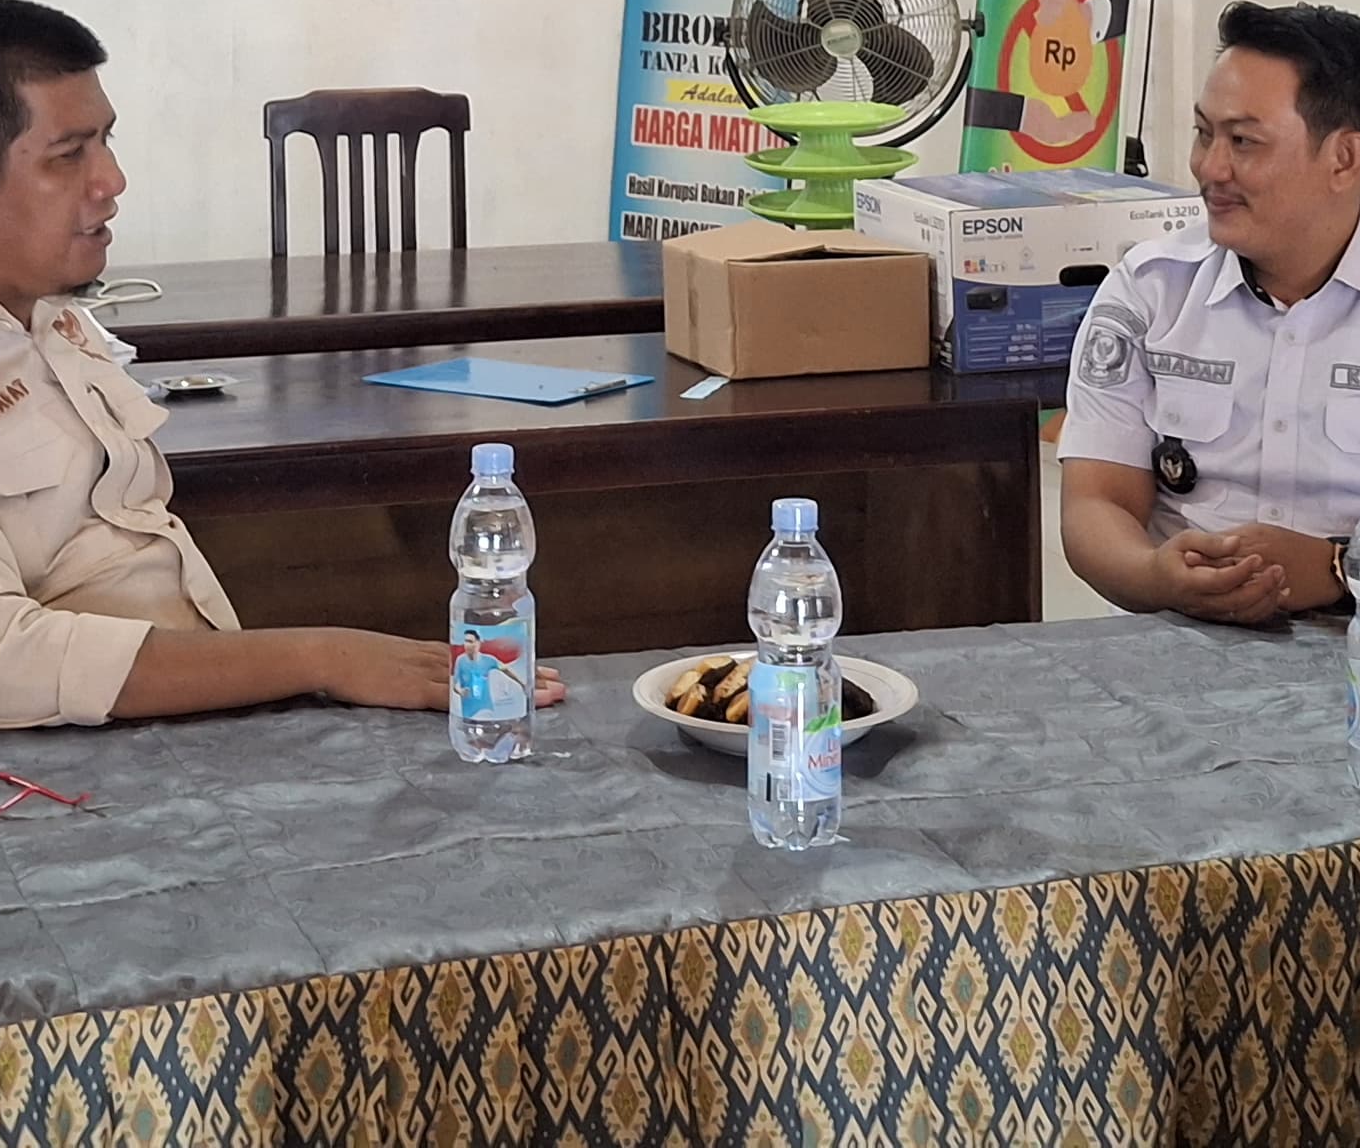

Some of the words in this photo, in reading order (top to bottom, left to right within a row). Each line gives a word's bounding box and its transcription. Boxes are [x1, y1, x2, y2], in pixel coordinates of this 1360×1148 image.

[640, 50, 699, 74] TANPA
[1044, 39, 1076, 71] Rp
[634, 107, 703, 149] HARGA
[708, 114, 761, 153] MATI
[628, 175, 655, 197] Hasil
[657, 178, 698, 202] Korupsi
[700, 185, 736, 206] Bukan
[856, 192, 882, 215] EPSON
[1129, 210, 1165, 221] EcoTank
[1166, 205, 1200, 218] L3210
[623, 213, 658, 240] MARI
[962, 216, 1024, 236] EPSON
